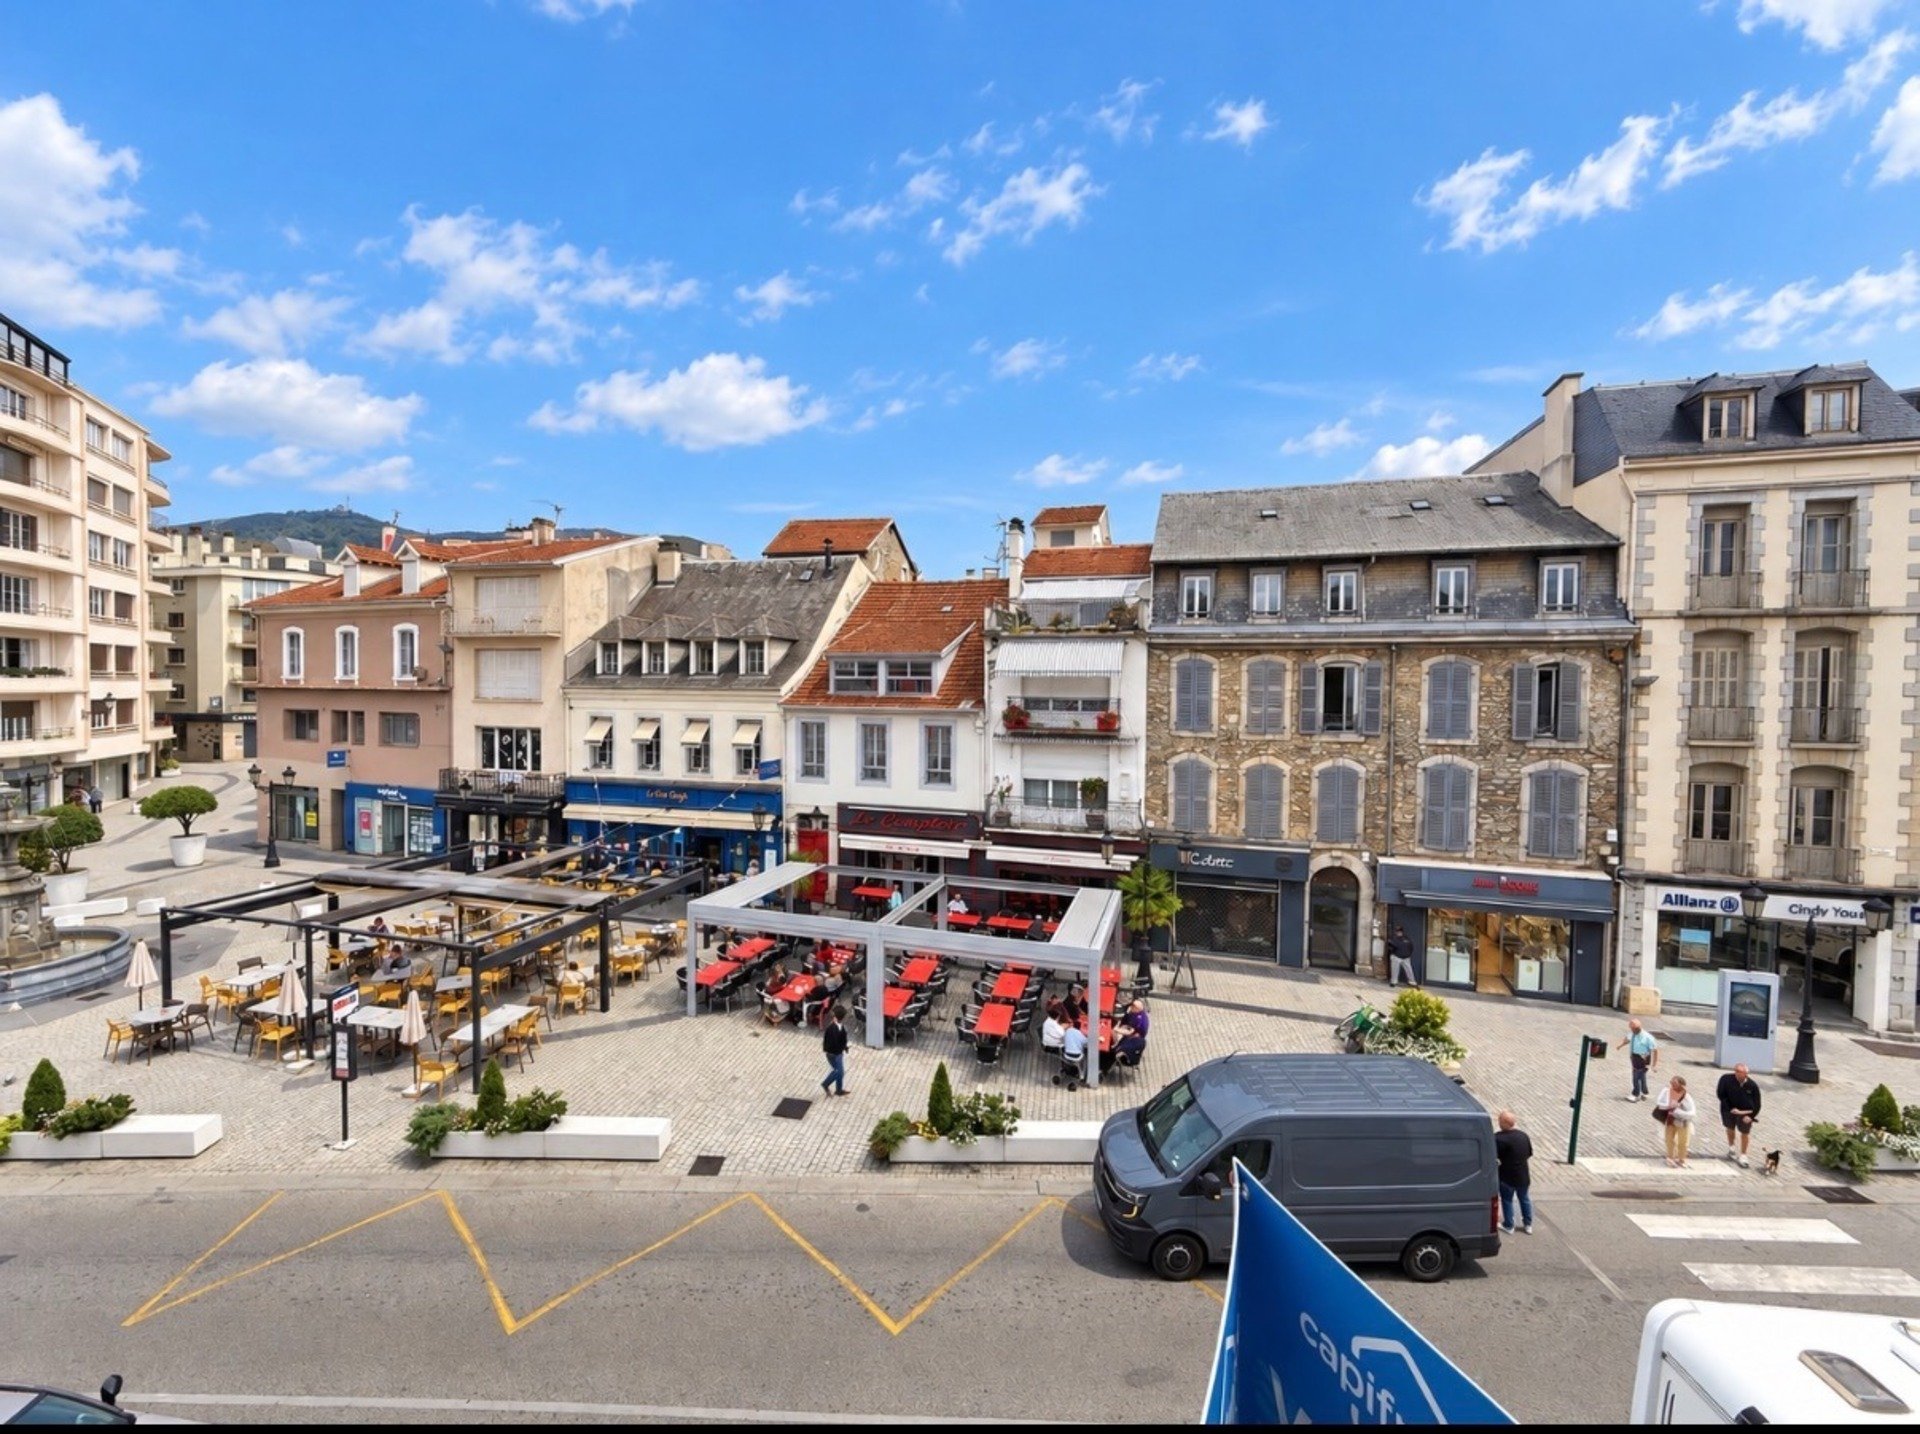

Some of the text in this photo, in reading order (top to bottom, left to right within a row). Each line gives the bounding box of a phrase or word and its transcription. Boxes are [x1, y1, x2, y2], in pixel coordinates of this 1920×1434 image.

[849, 811, 874, 826] Le
[1661, 893, 1717, 909] Allianz
[1788, 903, 1829, 918] Cindy
[1300, 1312, 1406, 1424] capif
